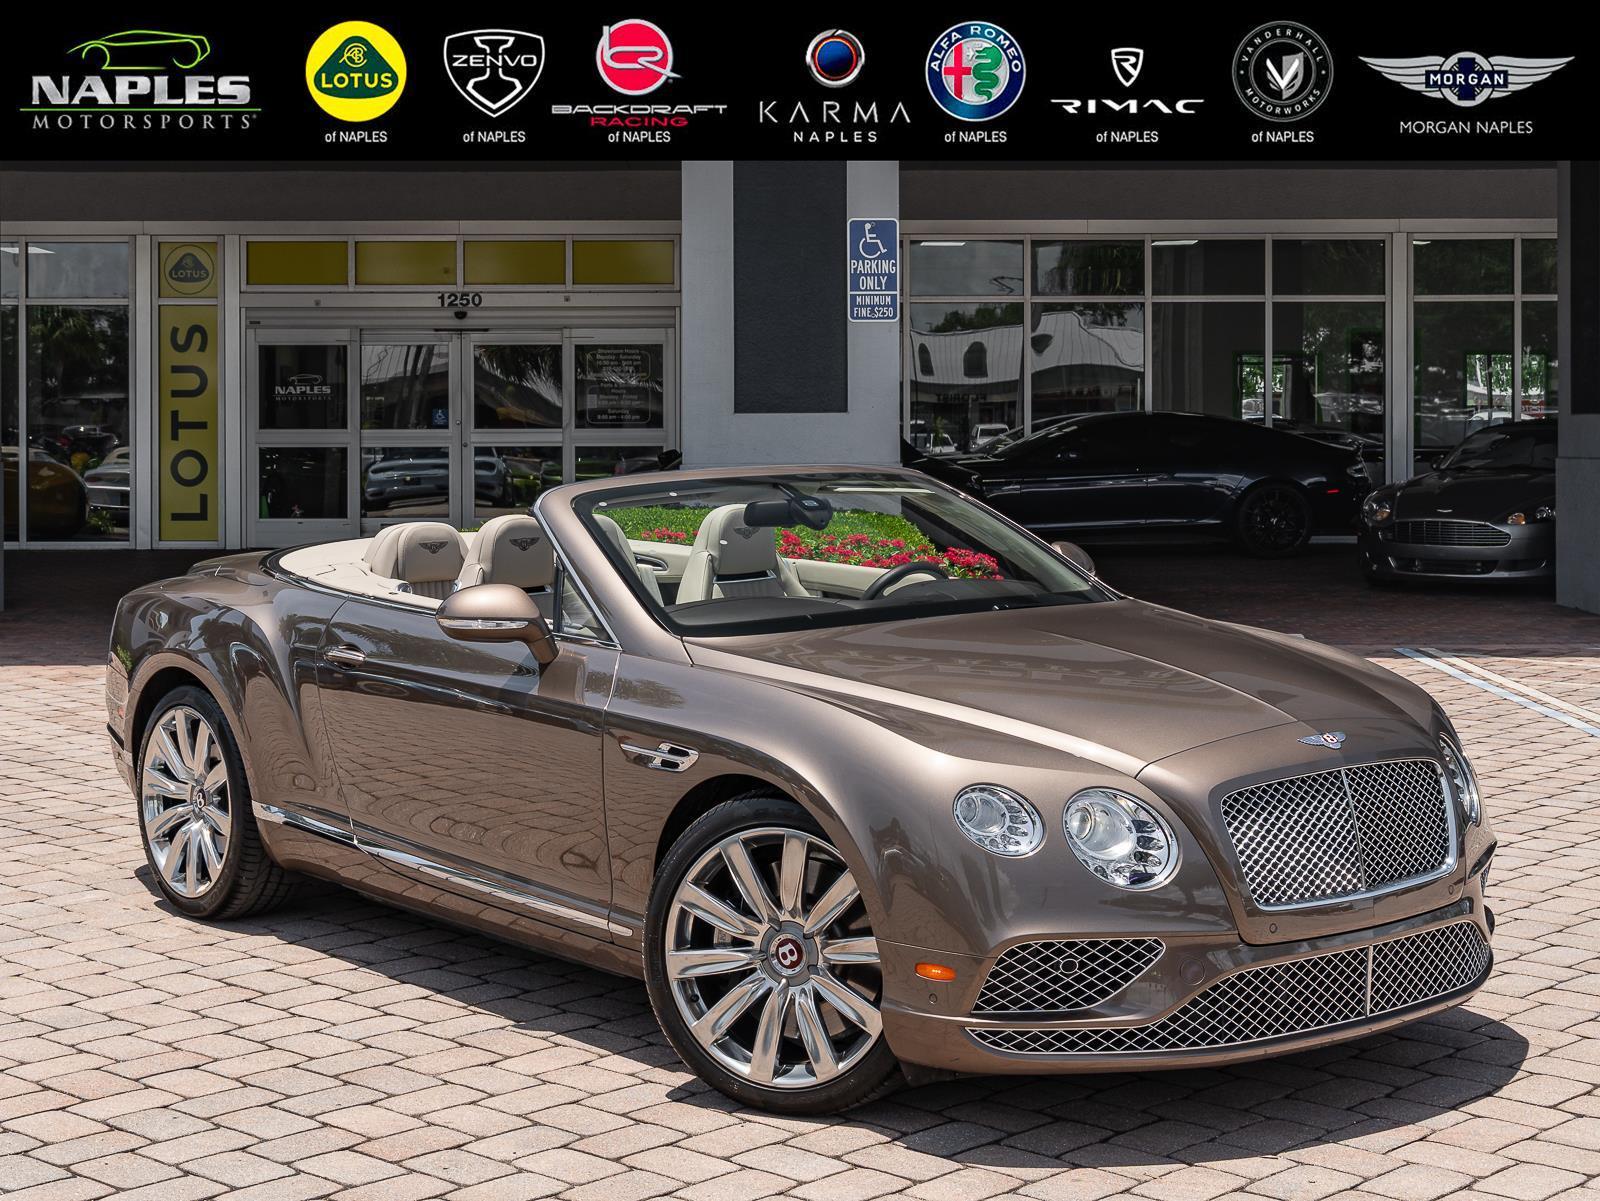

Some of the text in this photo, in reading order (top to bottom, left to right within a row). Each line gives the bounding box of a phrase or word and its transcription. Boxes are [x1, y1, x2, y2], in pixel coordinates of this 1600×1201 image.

[850, 259, 896, 274] PARKING
[171, 270, 208, 279] LOTUS
[859, 275, 887, 290] ONLY
[438, 293, 482, 307] 1250
[856, 295, 891, 305] MINIMUM
[853, 306, 893, 318] FINE $250
[275, 386, 331, 394] NAPLES
[170, 324, 208, 521] LOTUS
